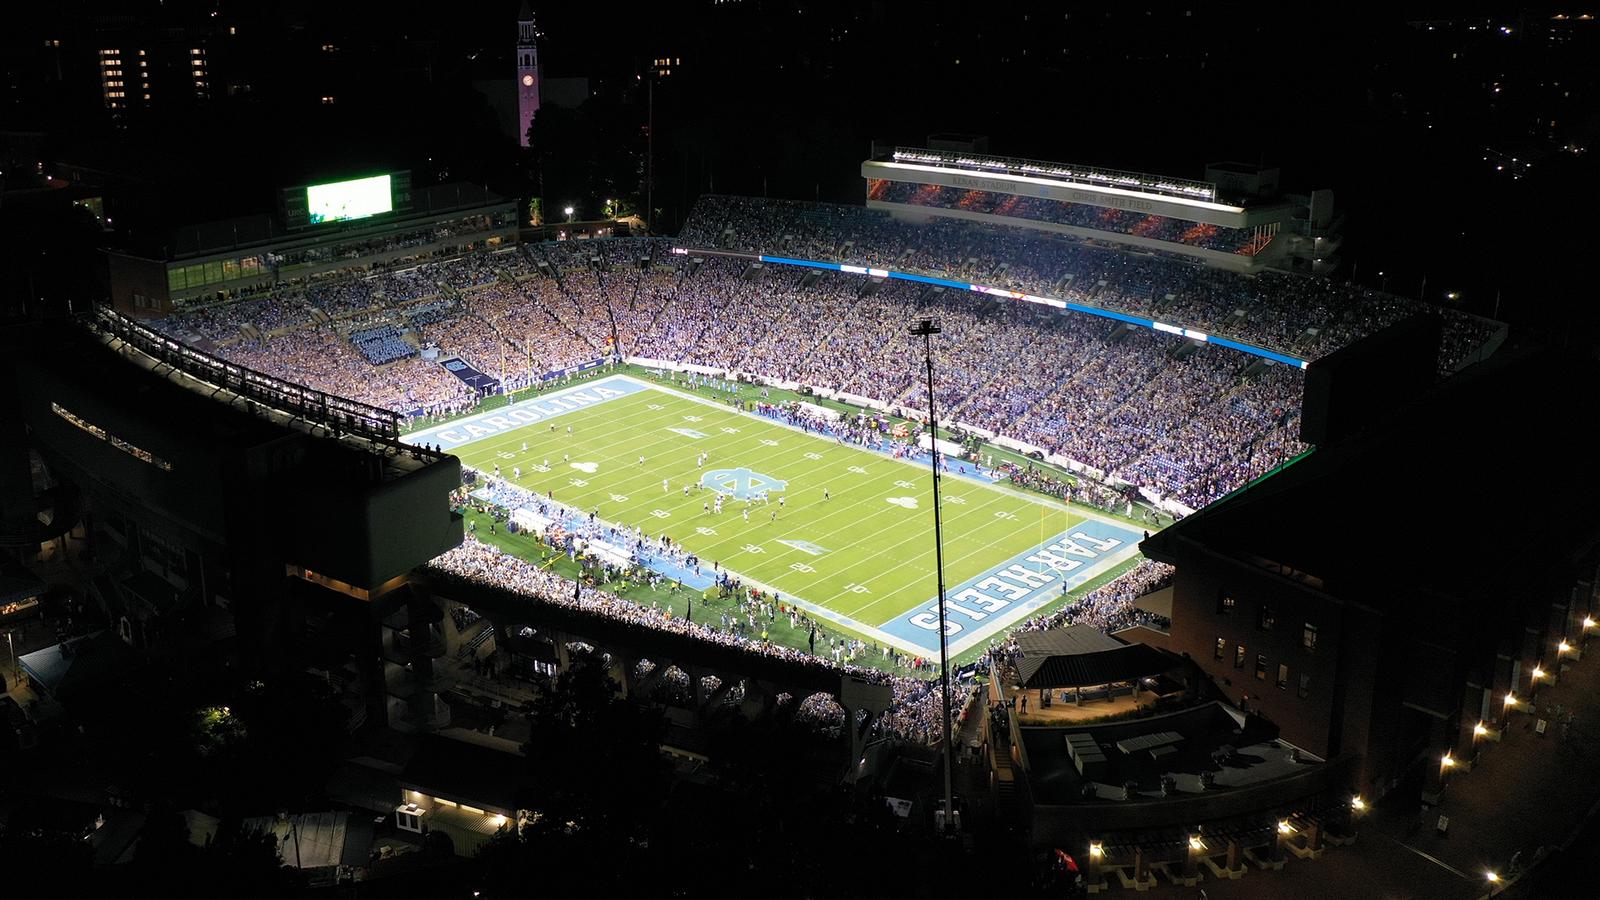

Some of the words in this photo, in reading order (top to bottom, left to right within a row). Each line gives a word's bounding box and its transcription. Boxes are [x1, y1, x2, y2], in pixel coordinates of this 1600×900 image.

[952, 177, 977, 187] KENAN
[978, 179, 1017, 192] STADIUM
[1072, 192, 1097, 202] CHRIS
[1100, 196, 1126, 207] SMITH
[1129, 200, 1153, 210] FIELD
[436, 385, 626, 444] CAROLINA
[649, 509, 672, 519] 50
[740, 543, 764, 554] 30
[1025, 530, 1124, 571] TAR
[790, 562, 813, 573] 20
[843, 583, 867, 594] 10
[908, 563, 1058, 637] HEELS
